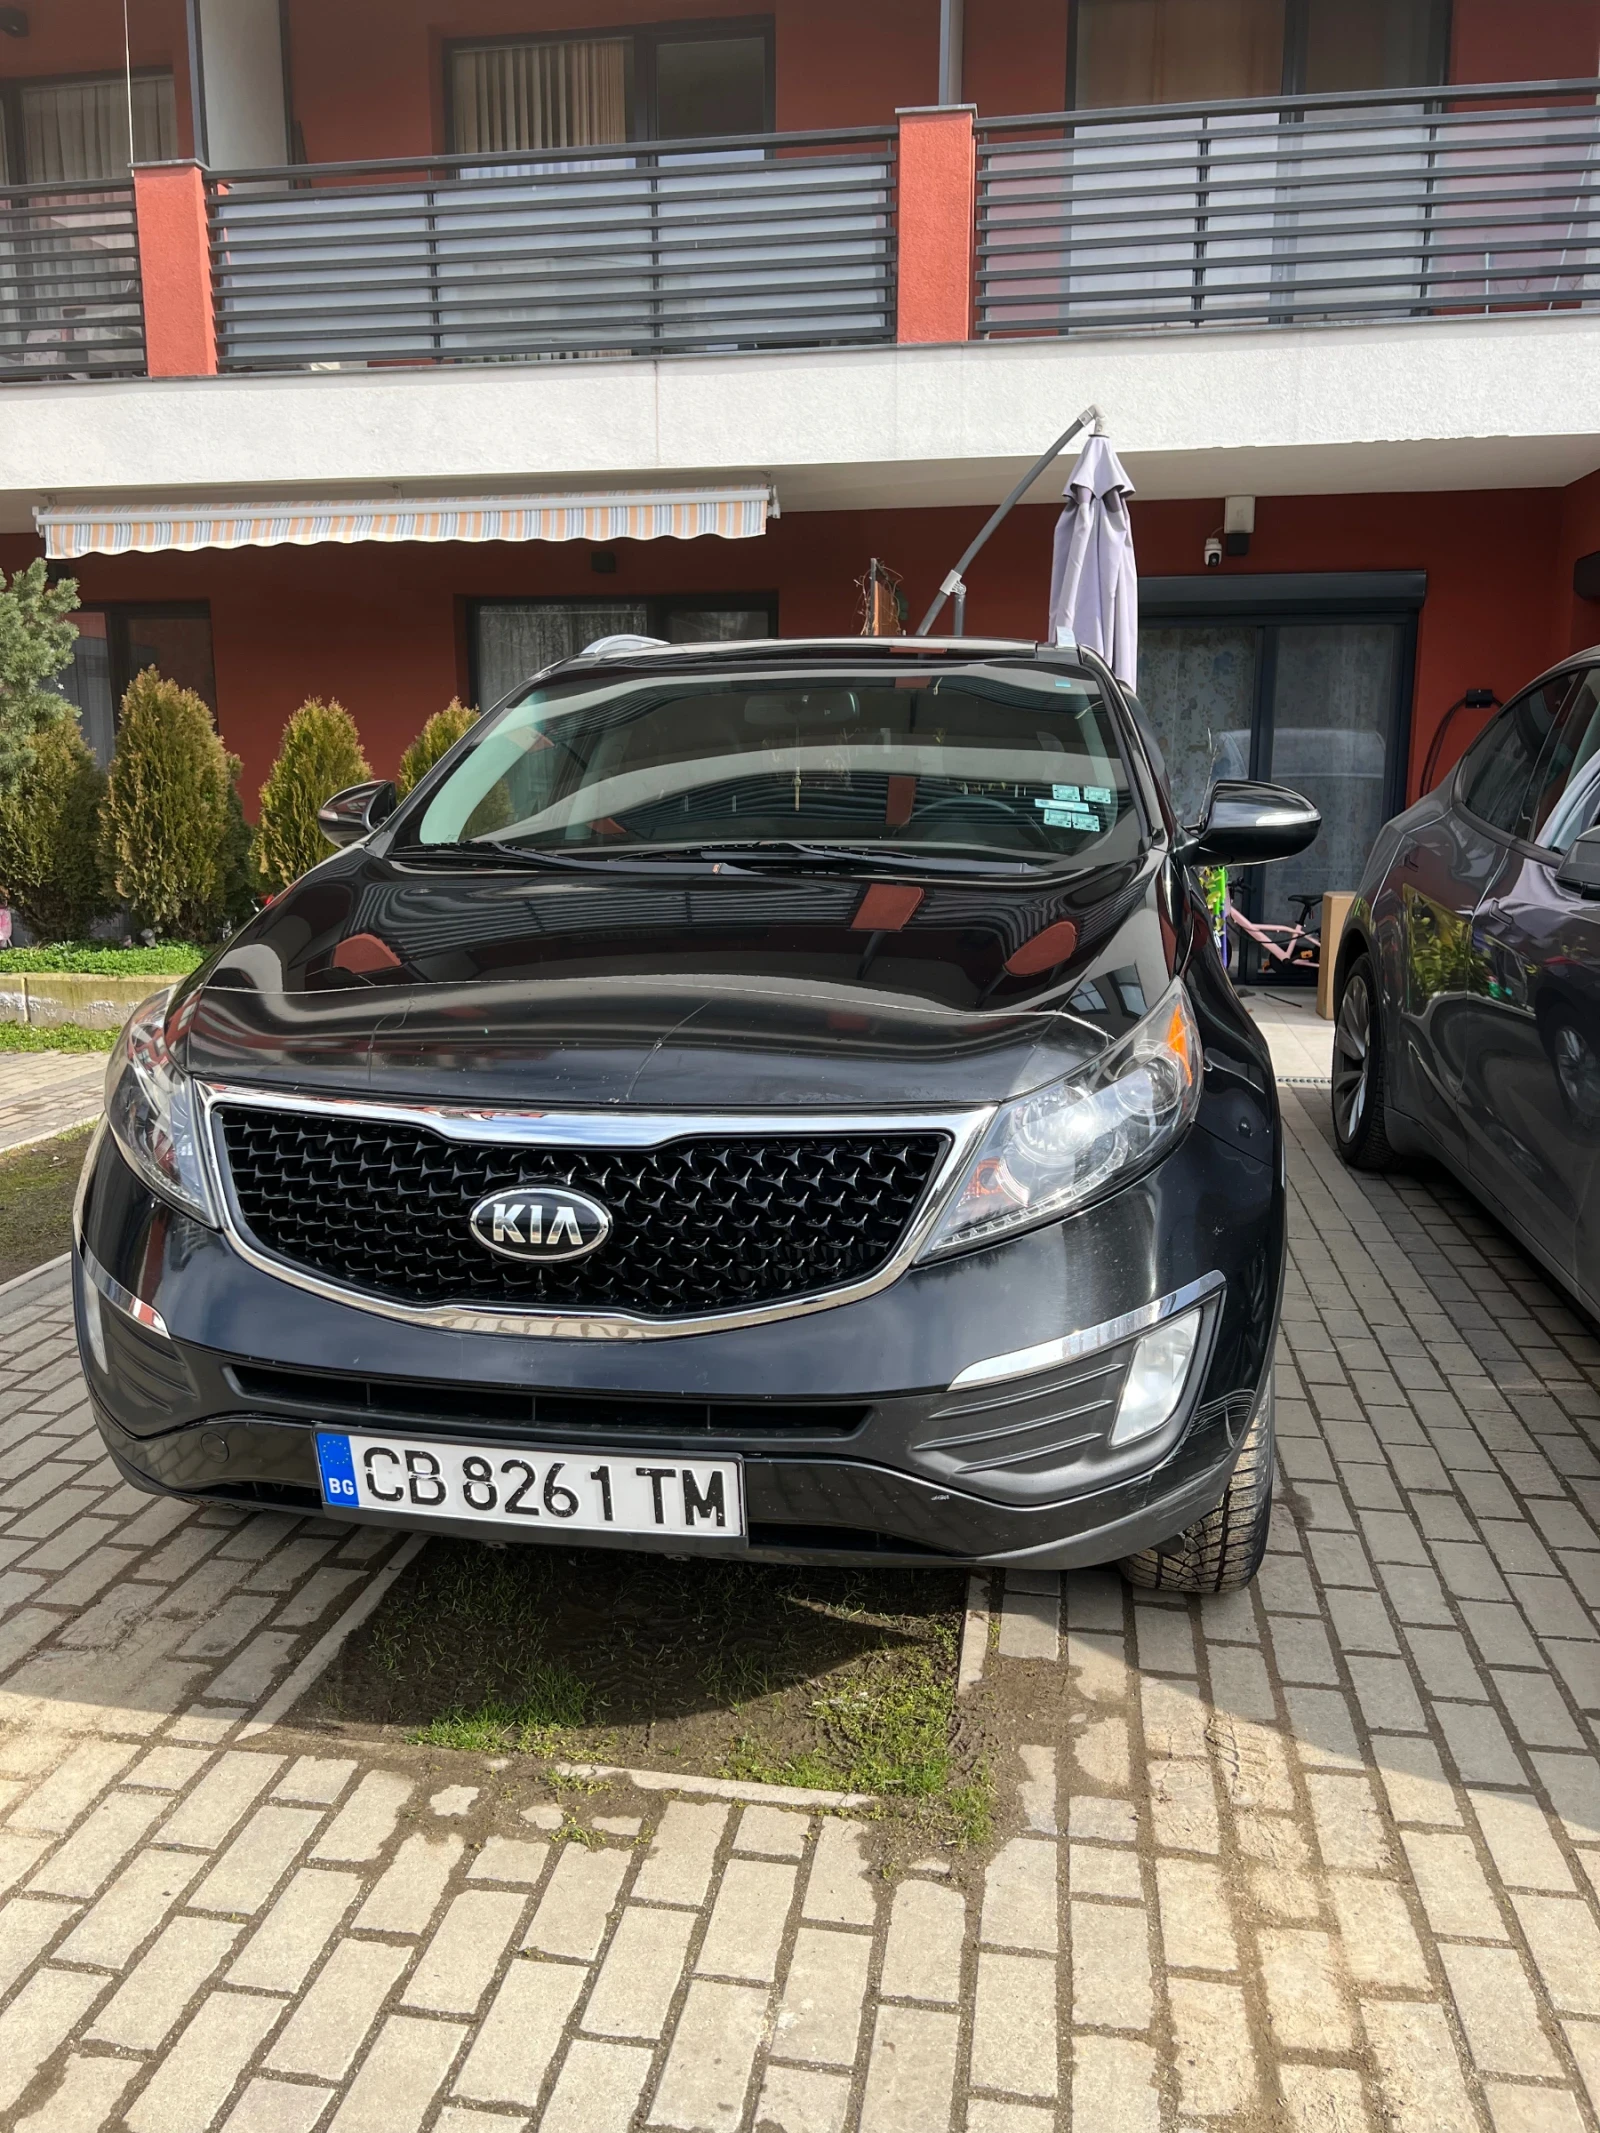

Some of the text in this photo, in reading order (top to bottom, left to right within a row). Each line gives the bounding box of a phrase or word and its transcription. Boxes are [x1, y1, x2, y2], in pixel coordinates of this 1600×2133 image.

[493, 1203, 583, 1245] KIA
[328, 1477, 355, 1496] BG
[364, 1446, 726, 1527] CB 8261 TM
